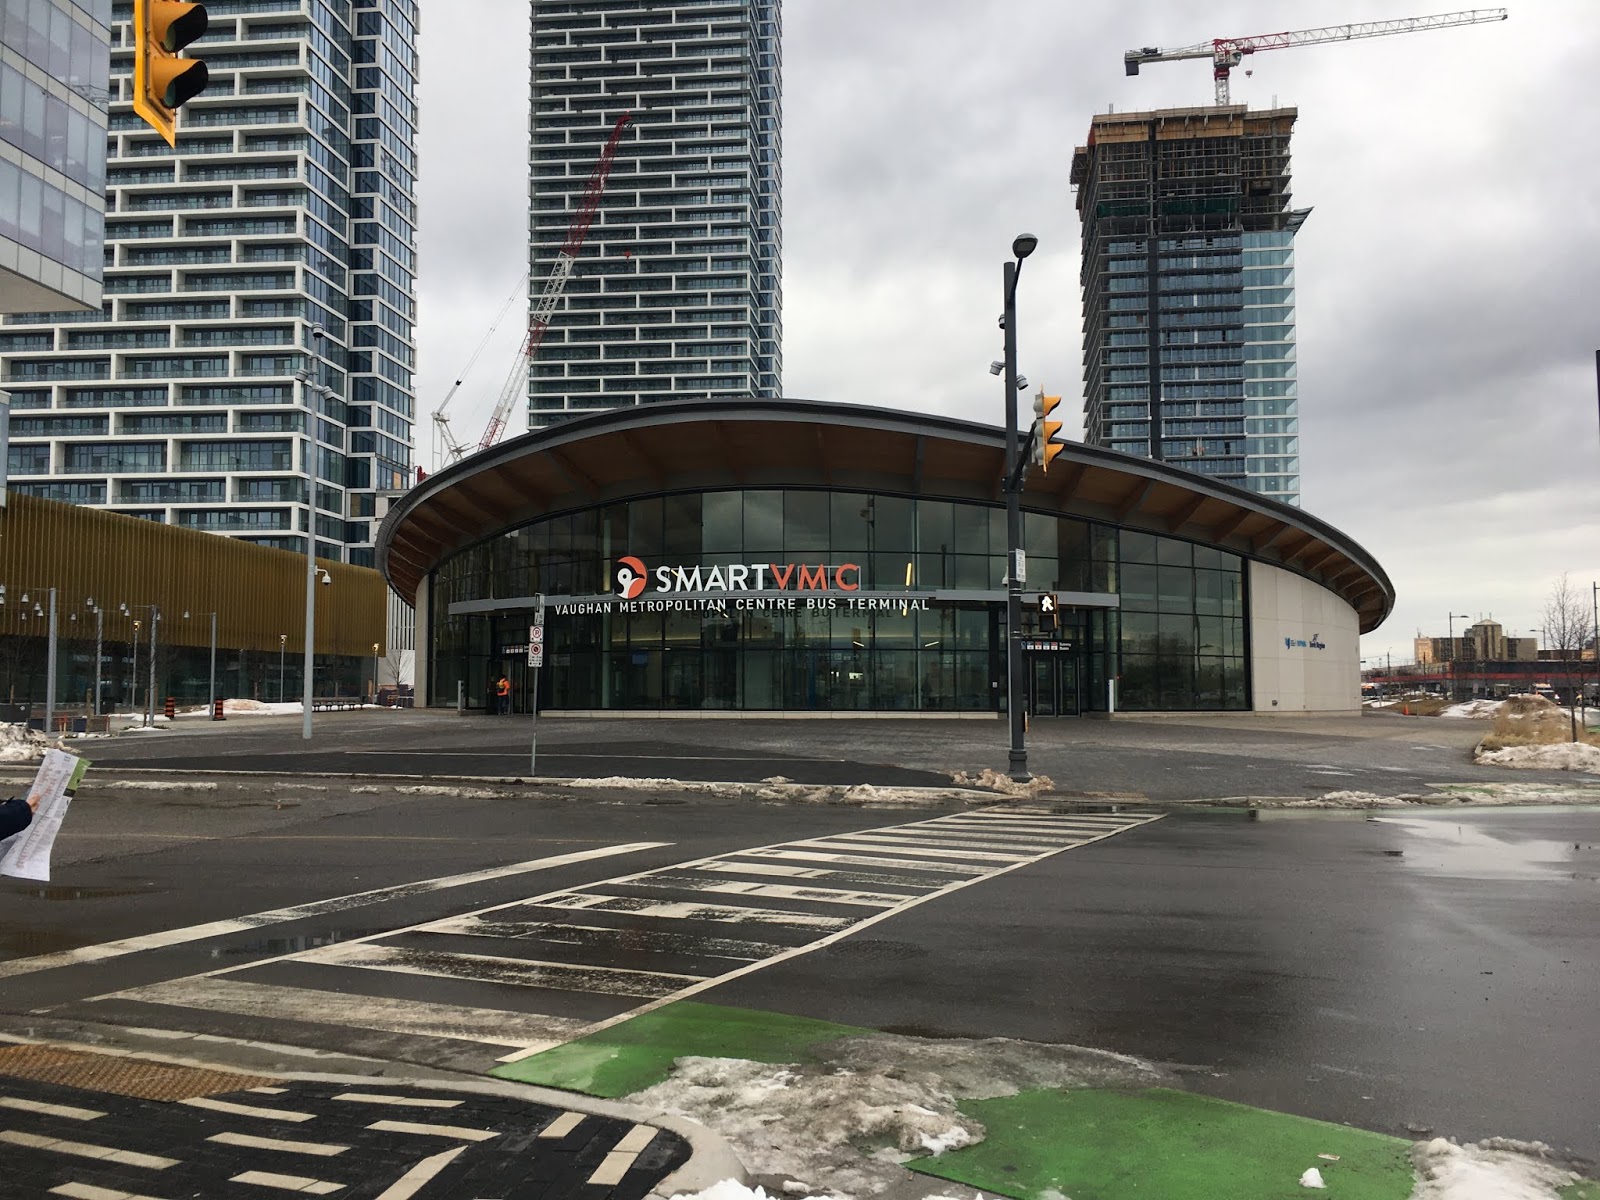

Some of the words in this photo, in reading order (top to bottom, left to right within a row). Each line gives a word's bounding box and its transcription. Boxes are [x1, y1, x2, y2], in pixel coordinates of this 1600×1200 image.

[555, 602, 612, 615] VAUGHAN
[620, 599, 726, 613] METROPOLITAN
[735, 598, 796, 610] CENTRE
[805, 598, 837, 610] BUS
[848, 598, 930, 611] TERMINAL
